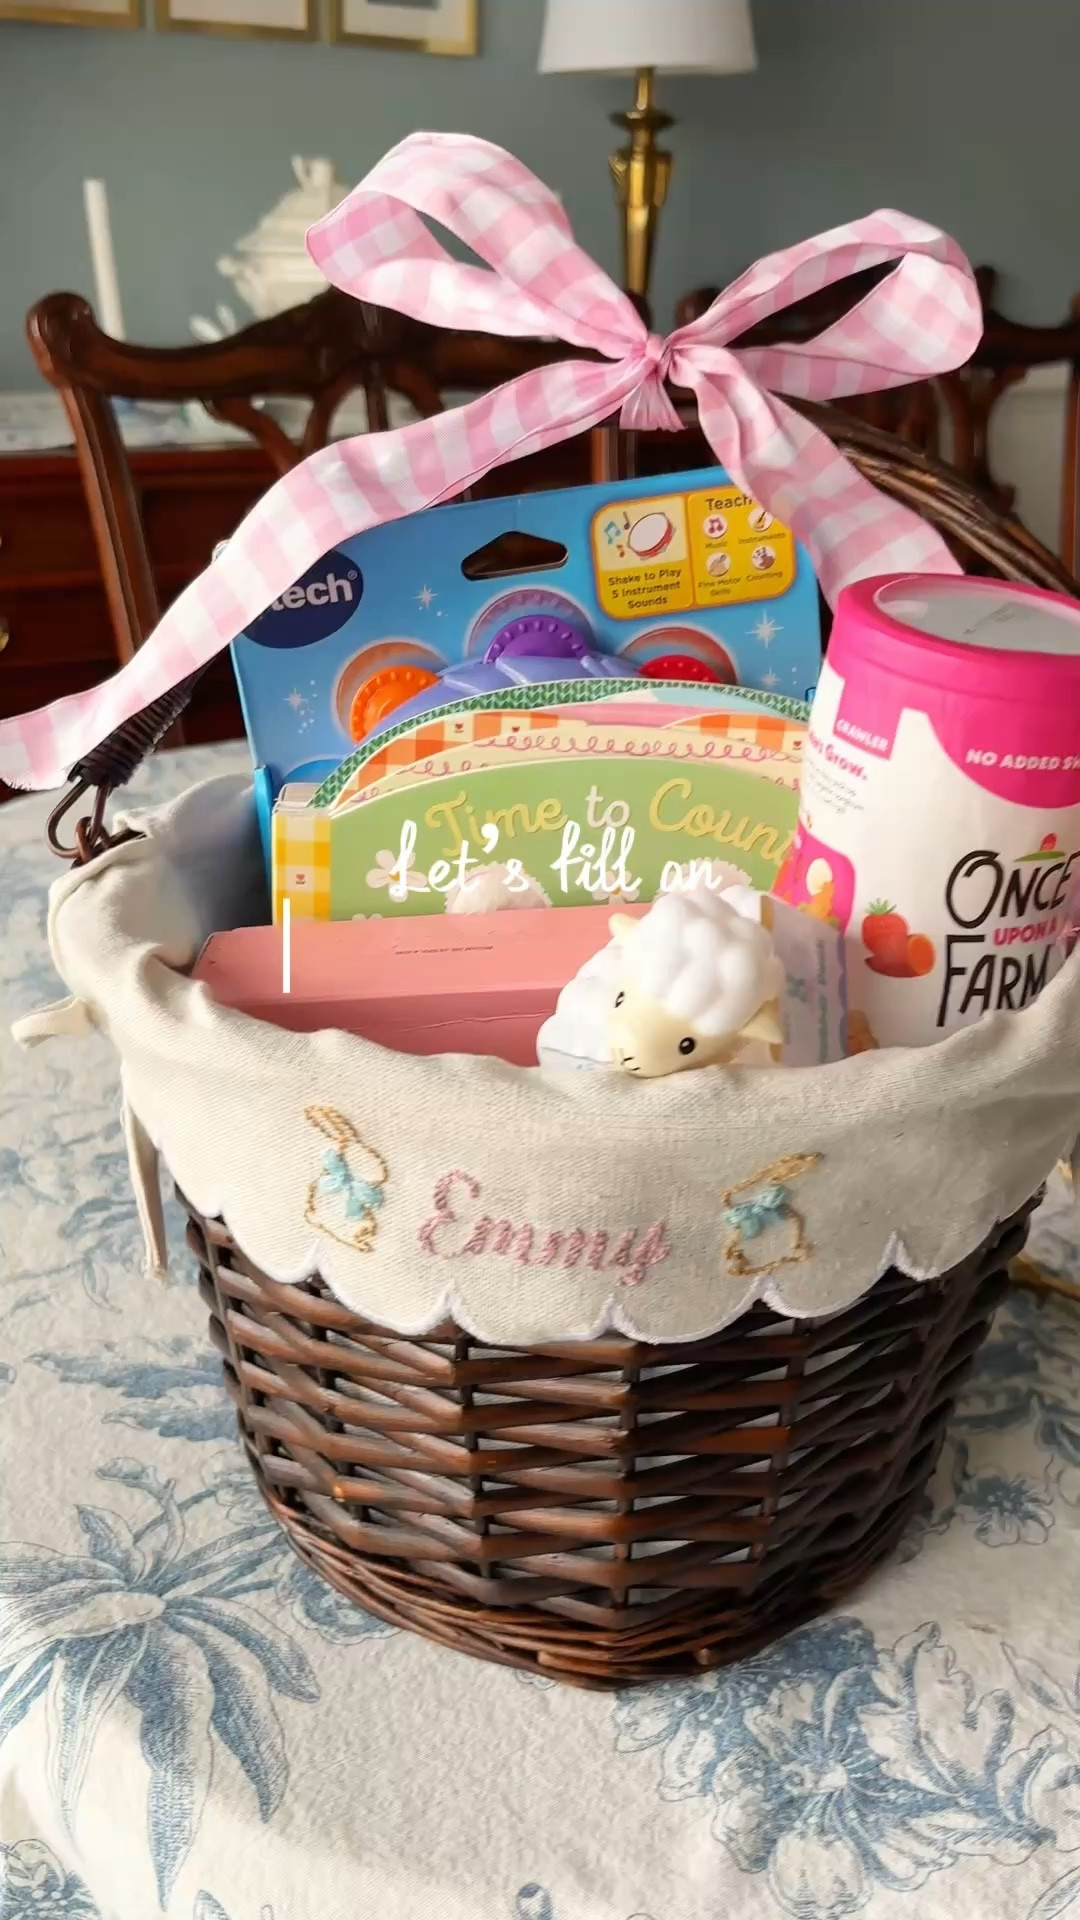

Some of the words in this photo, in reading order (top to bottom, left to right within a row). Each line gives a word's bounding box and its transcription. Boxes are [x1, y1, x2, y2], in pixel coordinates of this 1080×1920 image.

[608, 573, 641, 586] Shake
[644, 572, 656, 580] to
[658, 568, 682, 579] Play
[612, 590, 619, 598] 5
[622, 581, 681, 597] Instrument
[628, 597, 668, 609] Sounds
[965, 749, 998, 766] NO
[1000, 755, 1060, 769] ADDED
[425, 791, 568, 856] Time
[585, 784, 631, 829] to
[946, 849, 1080, 929] ONCE
[993, 928, 1048, 946] UPON
[936, 934, 1054, 1027] FARM
[416, 1168, 672, 1287] Emmy
